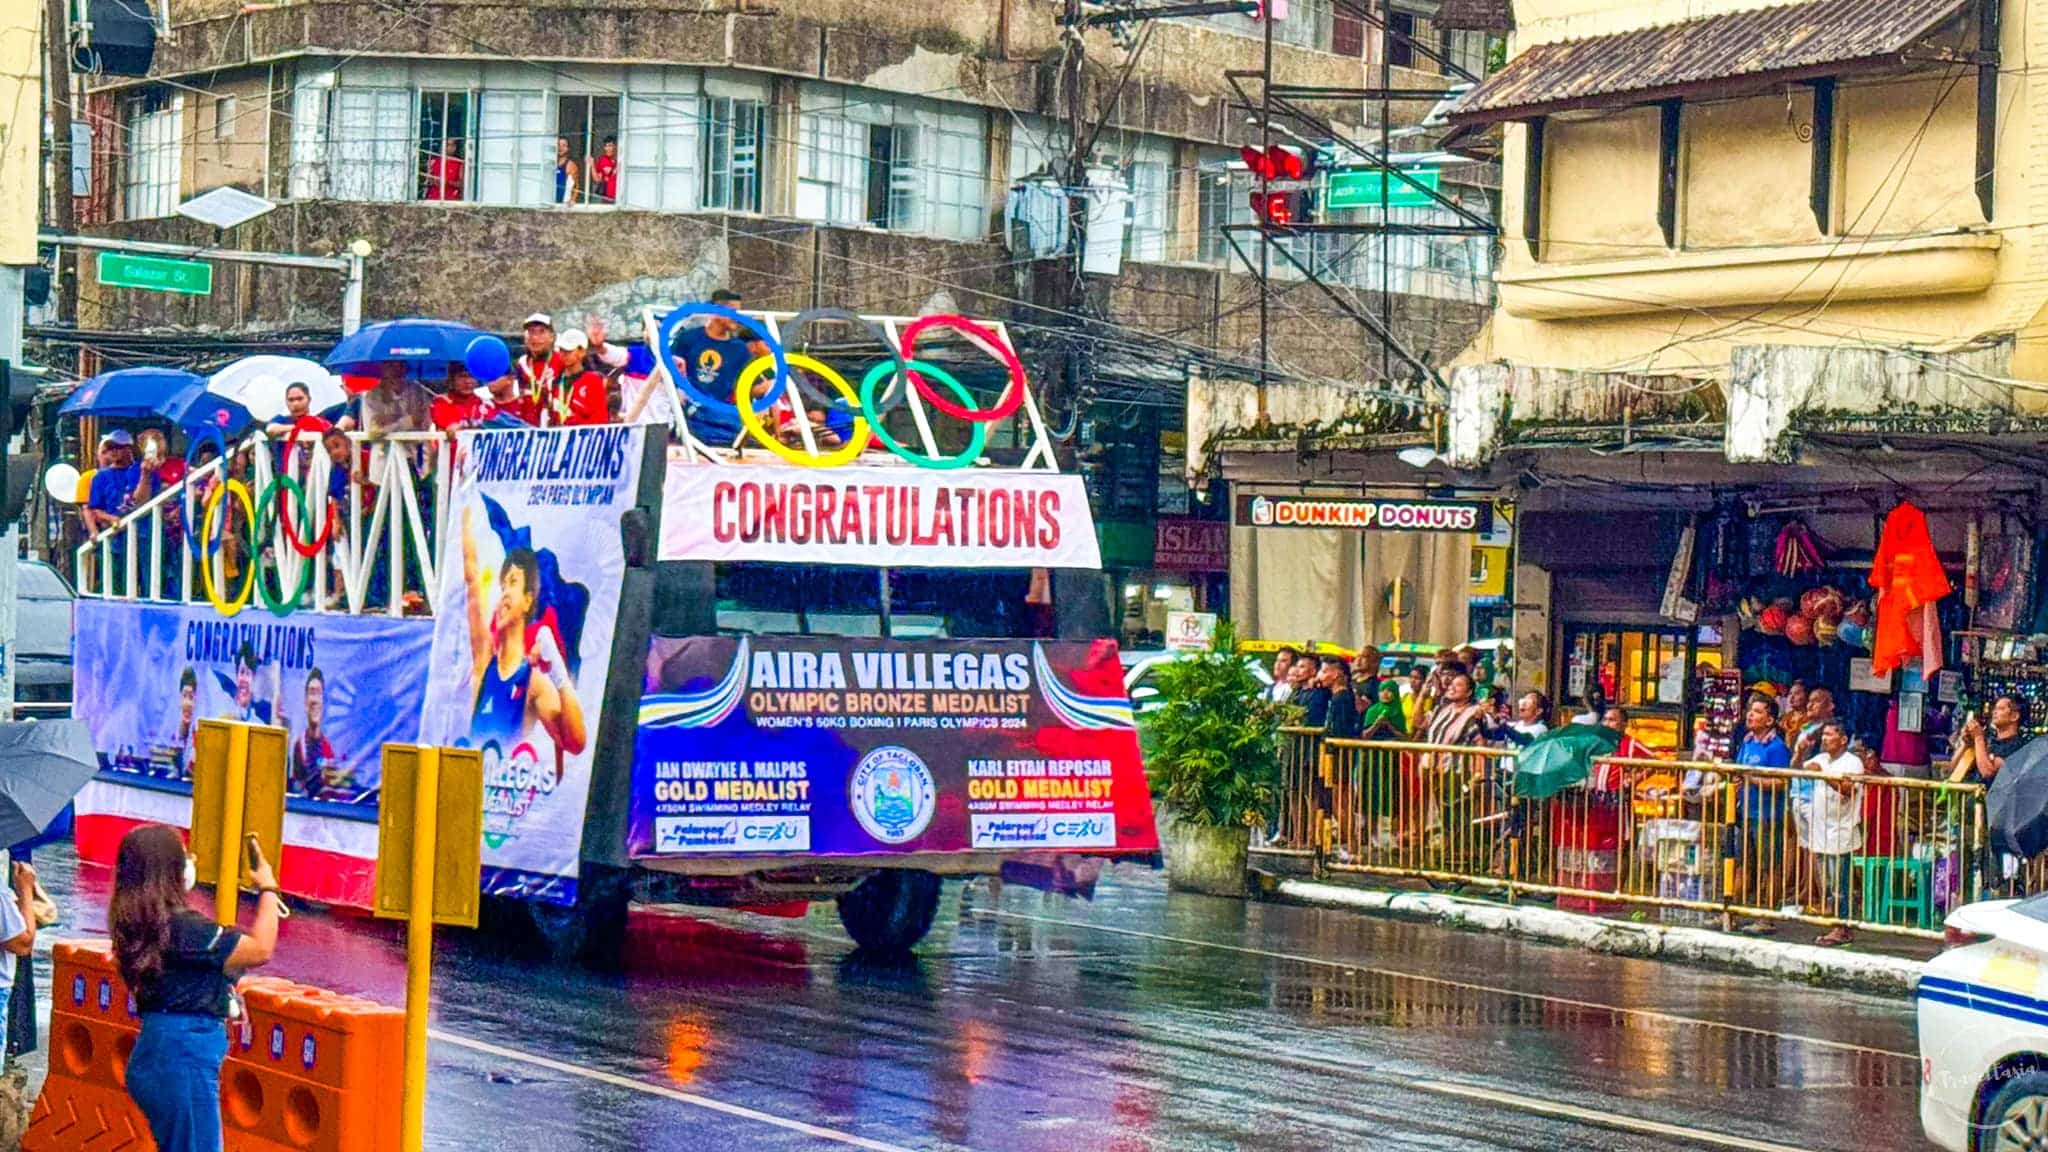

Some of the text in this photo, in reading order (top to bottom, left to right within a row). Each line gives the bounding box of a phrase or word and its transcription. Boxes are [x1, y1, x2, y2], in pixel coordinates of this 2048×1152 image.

[472, 426, 631, 483] CONGRATULATIONS
[713, 480, 1061, 551] CONGRATULATIONS
[1275, 501, 1477, 529] DUNKIN' DONUTS
[186, 619, 318, 671] CONGRATULATIONS
[750, 651, 1030, 691] AIRA VILLEGAS
[750, 691, 1031, 714] OLYMPIC BRONZE MEDALIST
[756, 715, 814, 729] WOMEN'S
[849, 716, 894, 728] BOXING
[903, 716, 938, 728] PARIS
[940, 716, 999, 728] OLYMPICS
[1000, 716, 1028, 728] 2024
[681, 761, 738, 779] DWAYNE
[739, 761, 753, 778] A.
[754, 761, 807, 779] MALPAS
[968, 760, 1112, 777] KARL EITAN REPOSAR
[655, 780, 810, 801] GOLD MEDALIST
[968, 778, 1113, 799] GOLD MEDALIST
[688, 803, 739, 813] SWIMMING
[740, 803, 779, 813] MEDLEY
[781, 802, 811, 812] RELAY
[1000, 801, 1046, 810] SWIMMING
[1048, 801, 1083, 810] MEDLEY
[1085, 801, 1114, 809] RELAY
